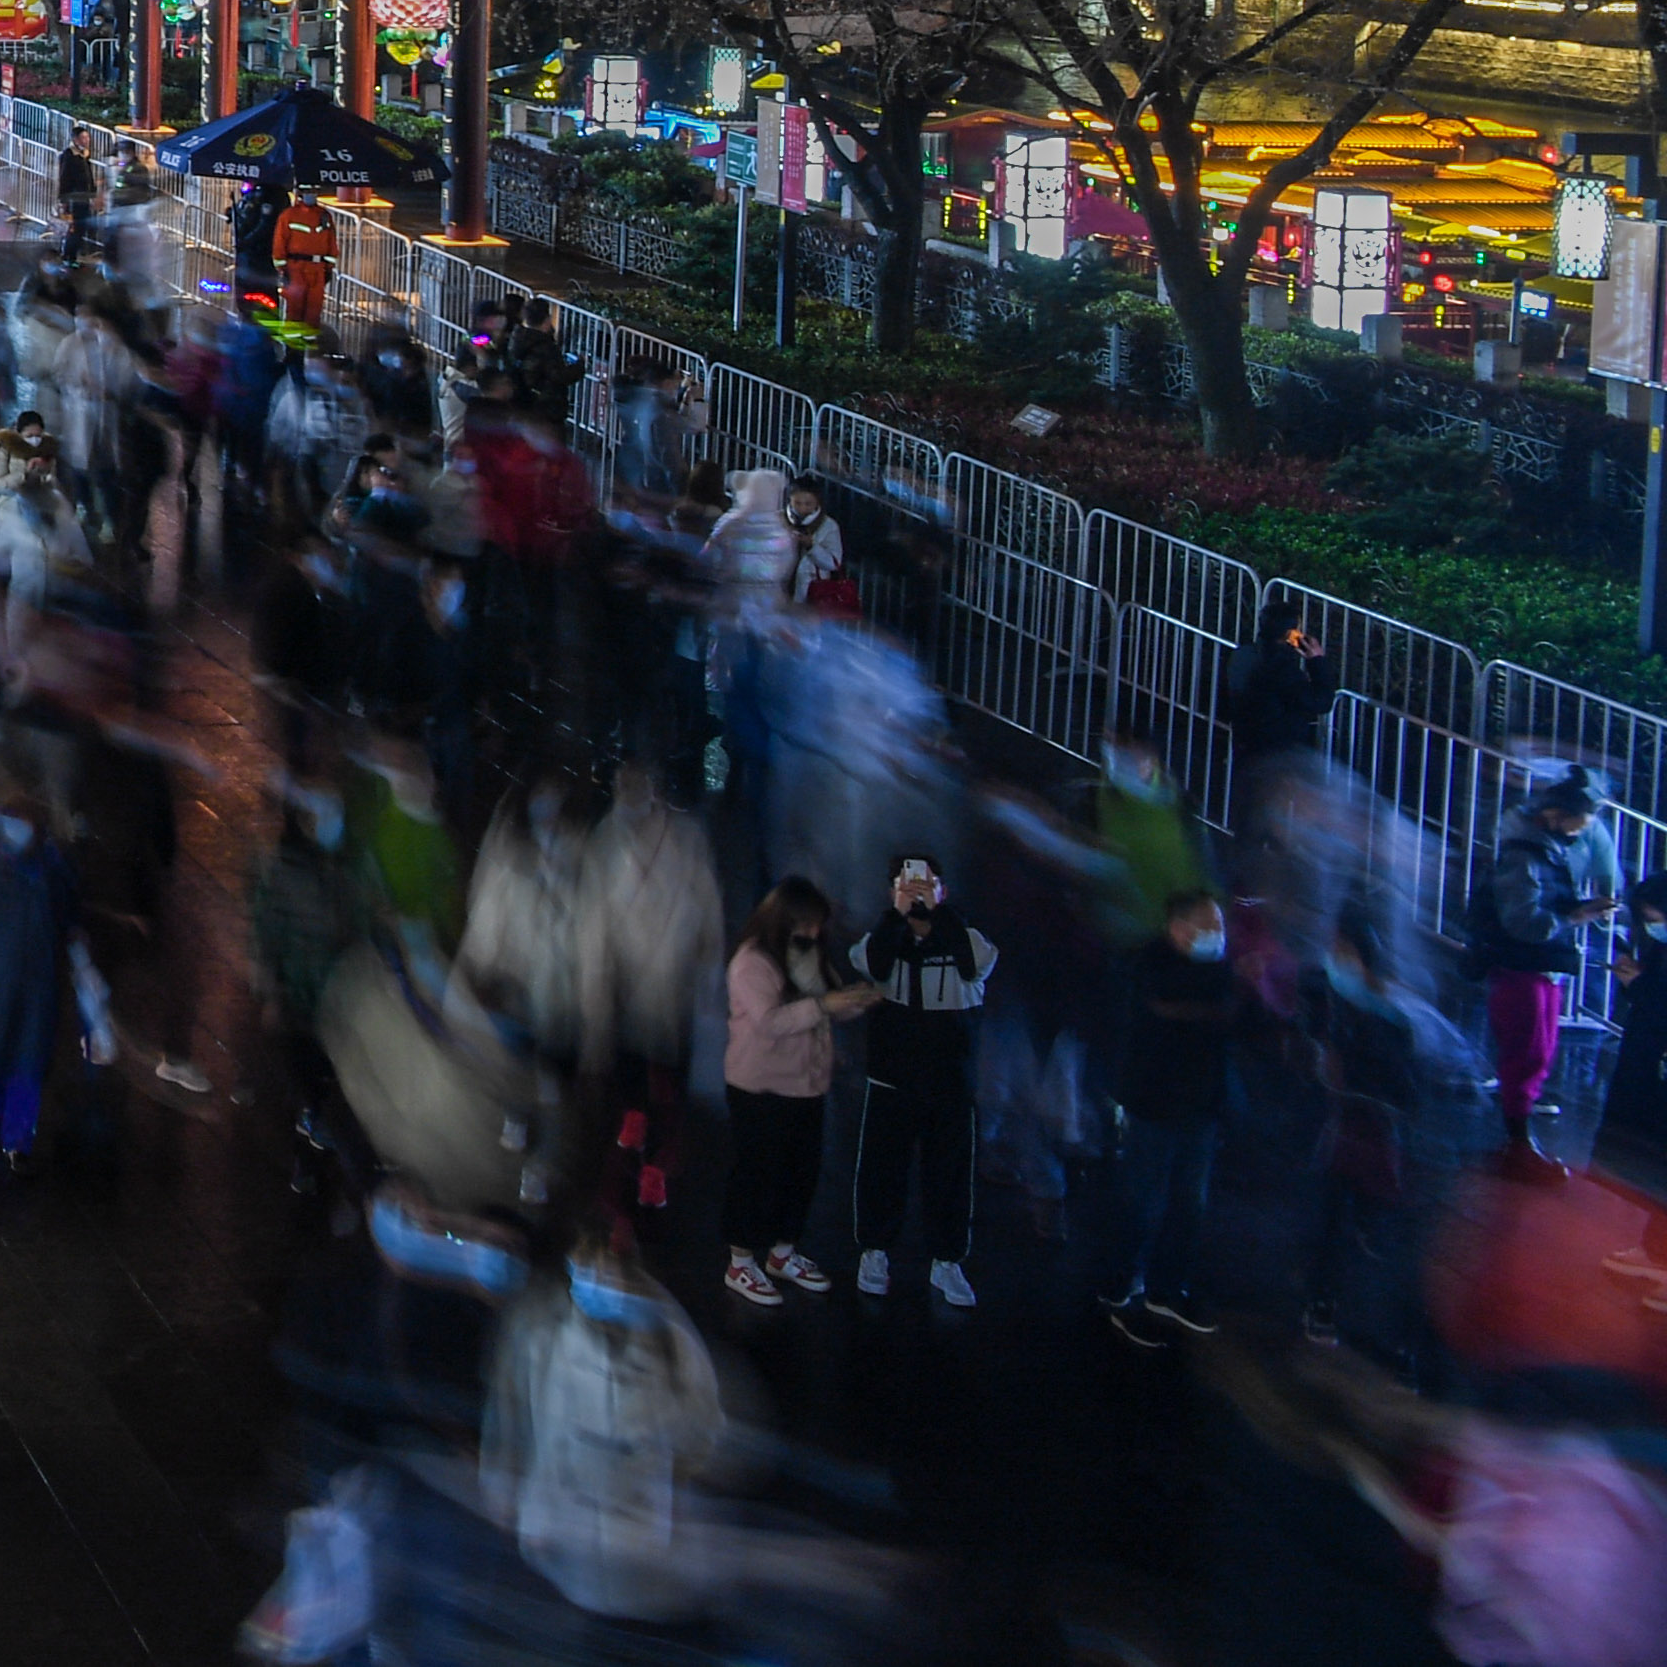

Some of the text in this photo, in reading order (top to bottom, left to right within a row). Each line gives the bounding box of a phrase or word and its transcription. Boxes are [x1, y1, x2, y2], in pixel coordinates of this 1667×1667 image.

[319, 148, 354, 163] 16
[212, 161, 260, 179] 公安执勤
[319, 169, 370, 183] POLICE
